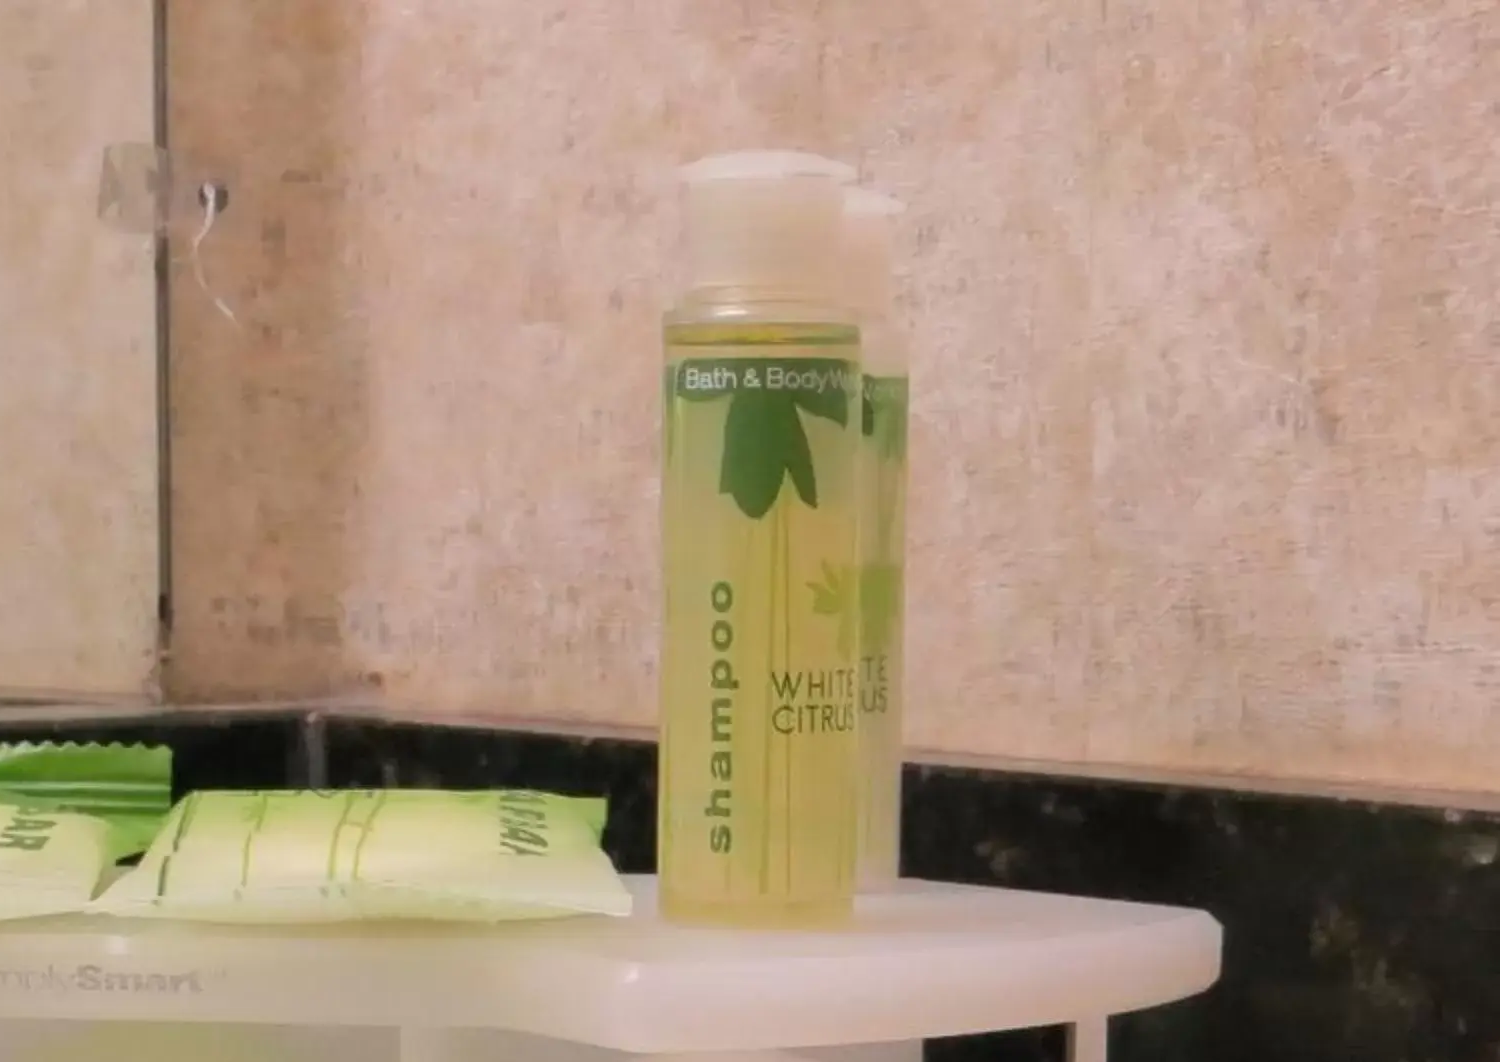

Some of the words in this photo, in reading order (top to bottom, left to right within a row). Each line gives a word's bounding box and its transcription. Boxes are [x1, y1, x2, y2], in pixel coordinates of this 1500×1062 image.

[684, 366, 737, 390] Bath
[743, 367, 761, 389] &
[771, 667, 855, 700] WHITE
[704, 580, 740, 855] shampoo
[771, 702, 854, 735] CITRUS
